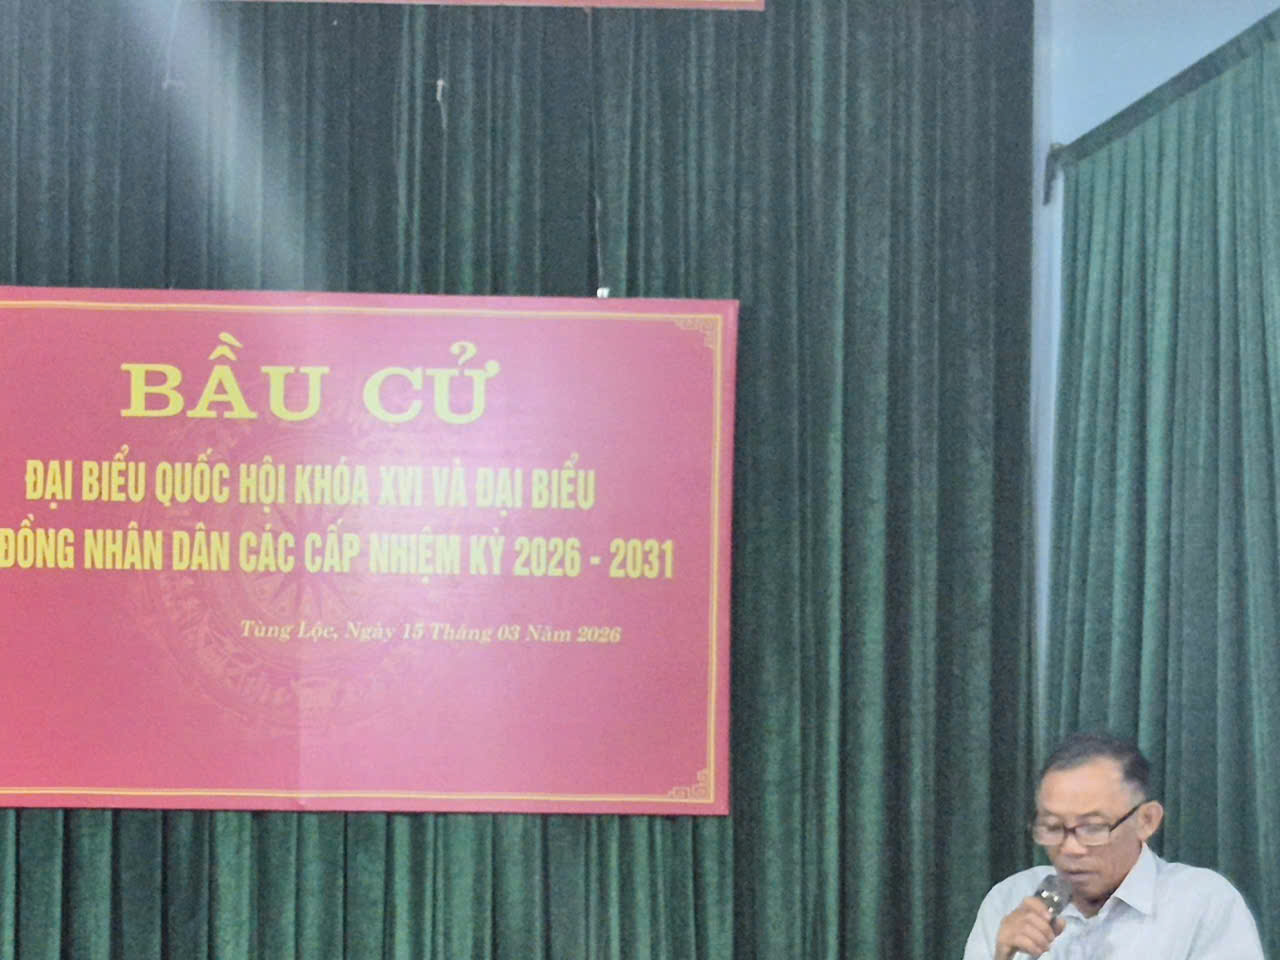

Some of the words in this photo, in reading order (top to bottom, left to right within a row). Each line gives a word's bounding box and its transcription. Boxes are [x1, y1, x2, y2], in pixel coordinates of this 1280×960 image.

[120, 331, 330, 422] BẦU
[362, 340, 501, 425] CỬ
[25, 459, 73, 510] ĐẠI
[81, 444, 146, 503] BIỂU
[155, 447, 231, 507] QUỐC
[239, 455, 286, 513] HỘI
[295, 456, 369, 505] KHÓA
[378, 465, 422, 505] XVI
[432, 457, 468, 507] VÀ
[476, 467, 523, 517] ĐẠI
[531, 452, 596, 510] BIỂU
[84, 520, 163, 570] NHÂN
[172, 521, 230, 571] DÂN
[239, 523, 296, 573] CÁC
[304, 518, 361, 573] CẤP
[369, 525, 462, 584] NHIỆM
[470, 527, 505, 576] KỲ
[513, 536, 582, 577] 2026
[609, 538, 674, 579] 2031
[241, 619, 292, 641] Tùng
[297, 620, 339, 643] Lộc,
[345, 620, 394, 643] Ngày
[401, 622, 425, 640] 15
[431, 622, 493, 644] Tháng
[497, 624, 521, 641] 03
[525, 624, 571, 642] Năm
[576, 626, 623, 643] 2026
